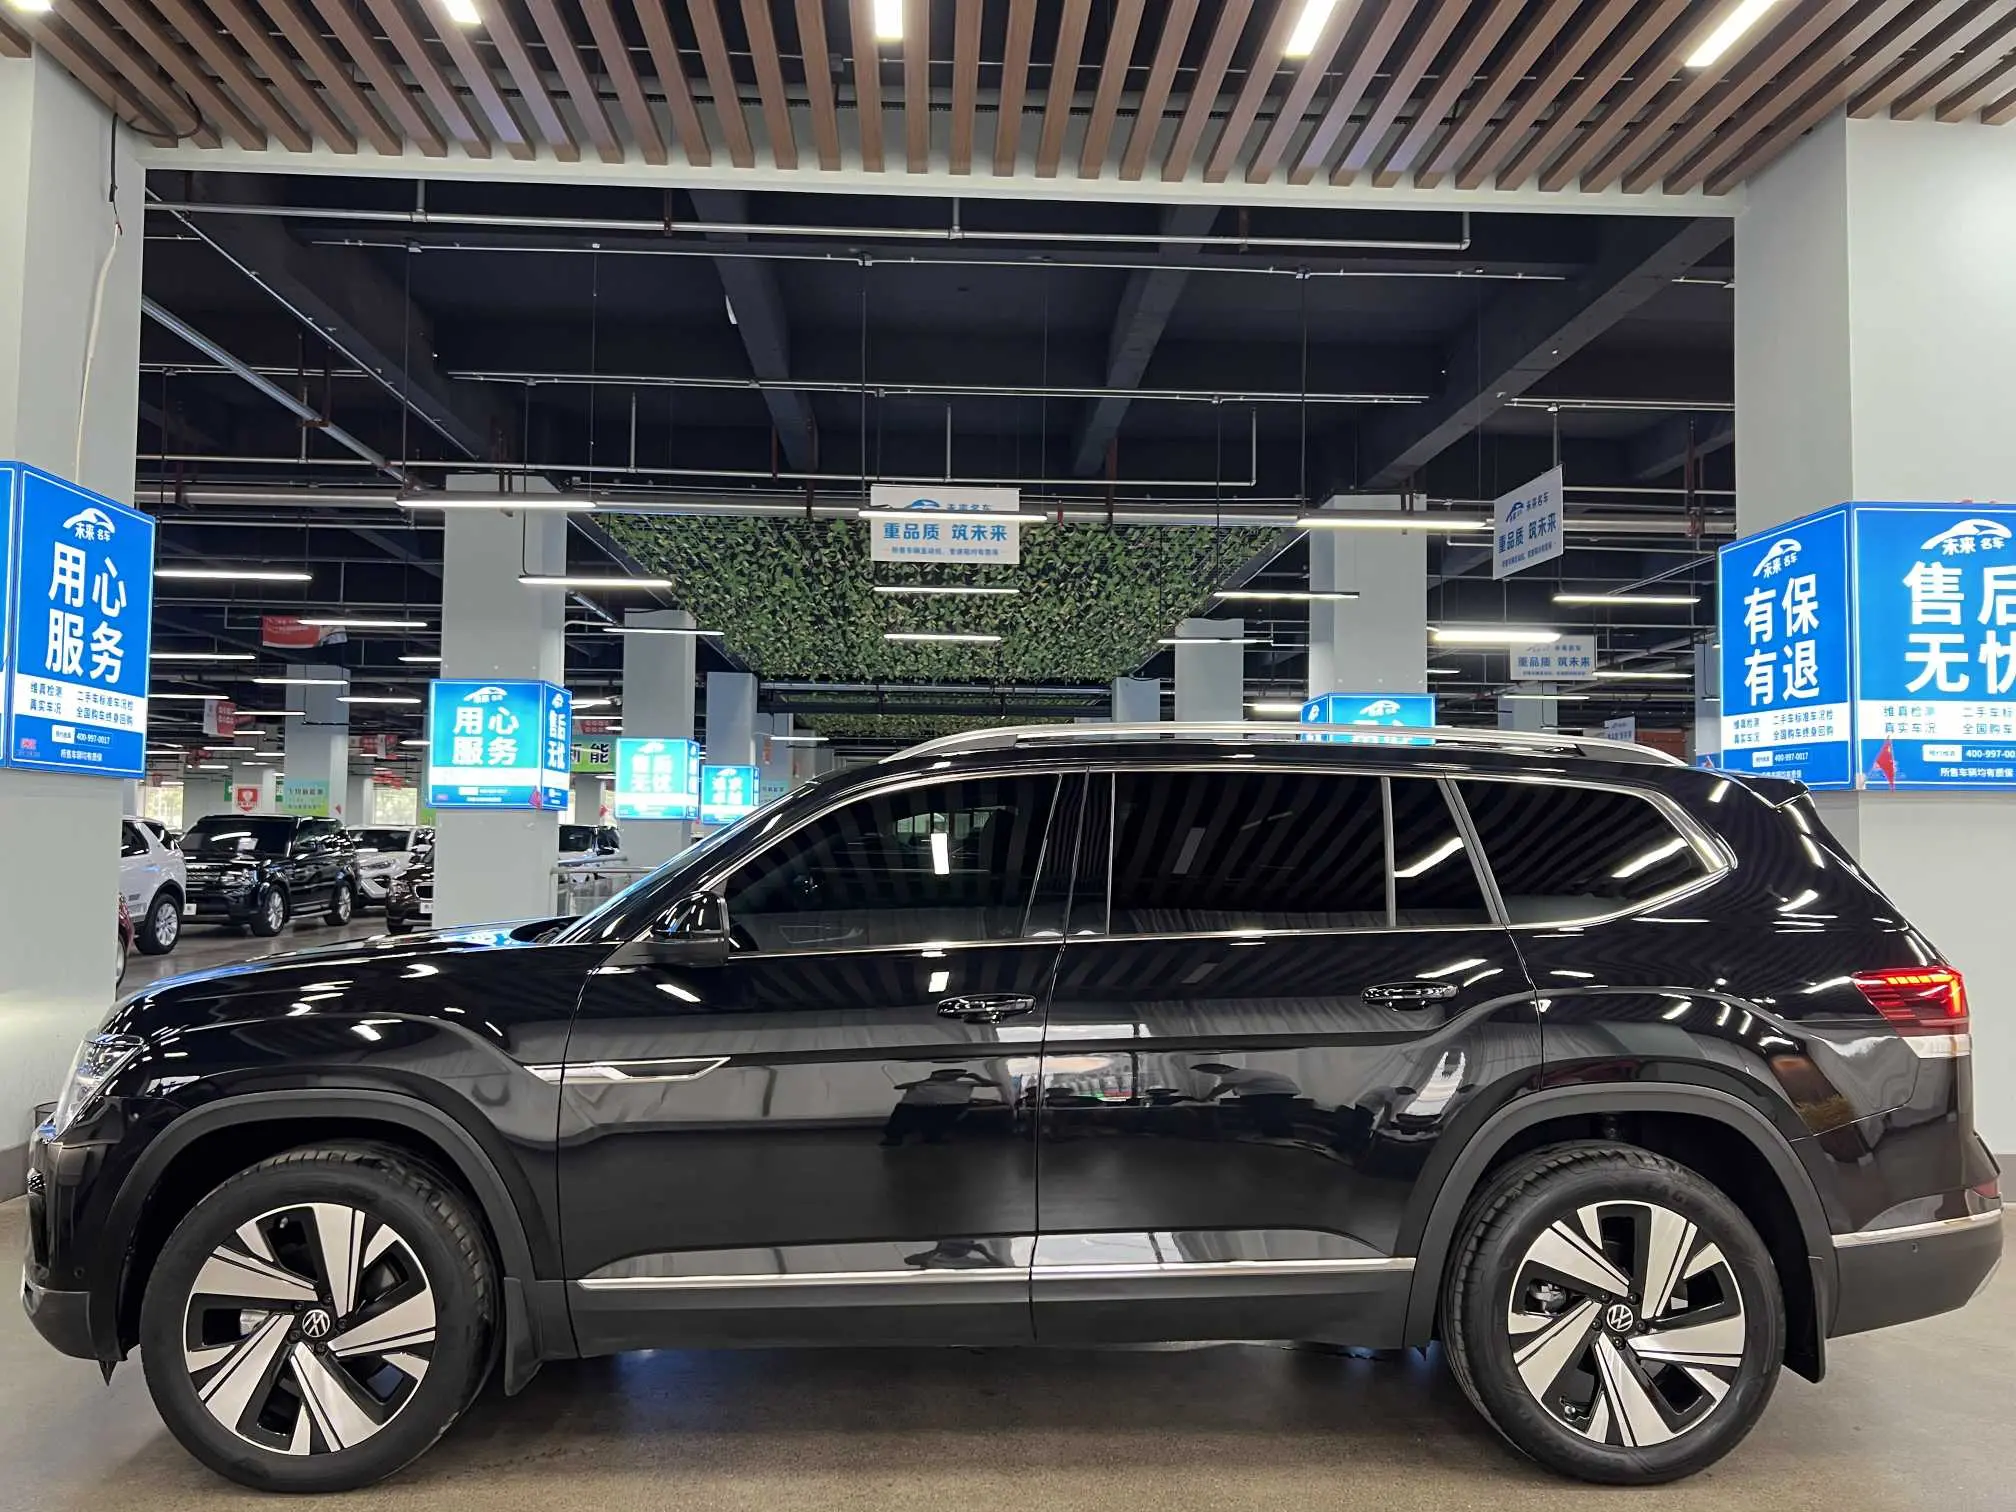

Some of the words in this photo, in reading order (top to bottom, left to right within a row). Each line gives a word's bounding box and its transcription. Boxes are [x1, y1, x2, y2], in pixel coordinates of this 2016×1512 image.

[883, 522, 940, 541] 重品质
[951, 523, 1008, 542] 筑未来
[1498, 526, 1524, 553] 重品质
[1529, 512, 1556, 539] 筑未来
[1942, 537, 1976, 556] 未来
[1980, 536, 2005, 550] 名车
[48, 541, 128, 617] 用心
[1744, 574, 1820, 645] 有保
[1902, 561, 2016, 626] 售后
[45, 608, 124, 684] 服务
[1744, 639, 1820, 706] 有退
[1905, 630, 2016, 694] 无忧
[452, 706, 520, 735] 用心
[452, 736, 519, 765] 服务
